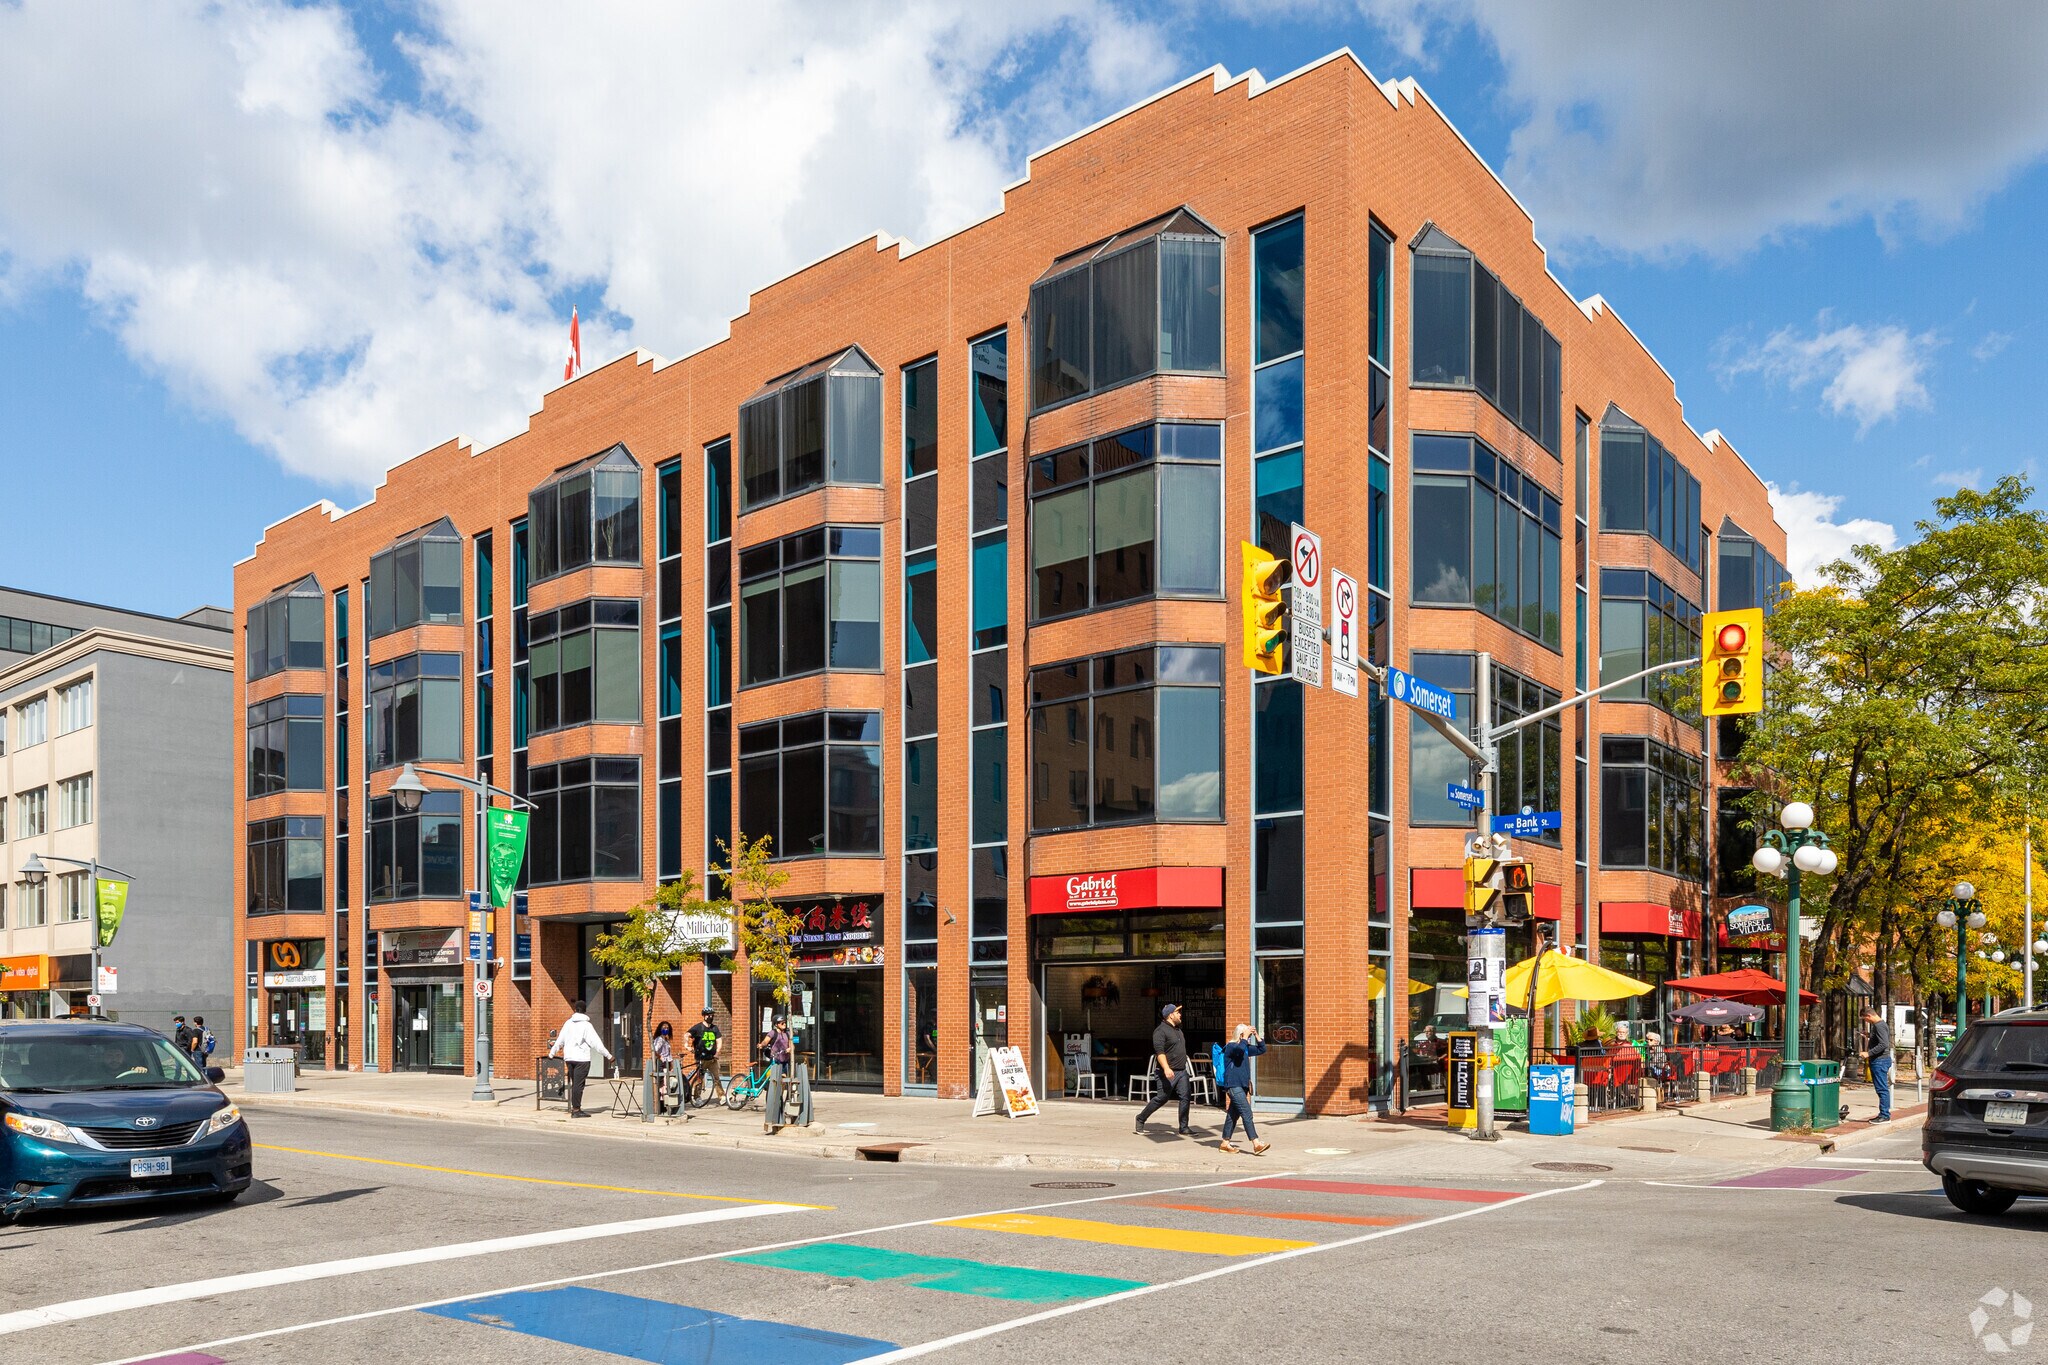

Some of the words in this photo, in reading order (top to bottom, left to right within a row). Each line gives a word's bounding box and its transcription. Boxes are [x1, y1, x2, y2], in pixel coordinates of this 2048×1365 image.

[1298, 622, 1316, 640] BUSES
[1294, 636, 1320, 656] EXCEPTED
[1295, 650, 1308, 665] SAUF
[1309, 656, 1319, 670] LES
[1296, 666, 1319, 684] AUTOBUS
[1410, 677, 1452, 717] Somerset
[1455, 788, 1472, 802] Somerset
[1516, 816, 1538, 828] Bank
[1066, 874, 1117, 896] Gabriel
[1081, 890, 1116, 898] PIZZA
[686, 919, 729, 936] Millichap
[1729, 919, 1765, 930] SOMERSET
[1739, 923, 1772, 935] VILLAGE
[391, 936, 407, 947] LAB
[1273, 1029, 1297, 1039] OPEN
[1457, 1062, 1468, 1104] FREE
[132, 1162, 152, 1173] CHSH
[155, 1161, 170, 1171] 981
